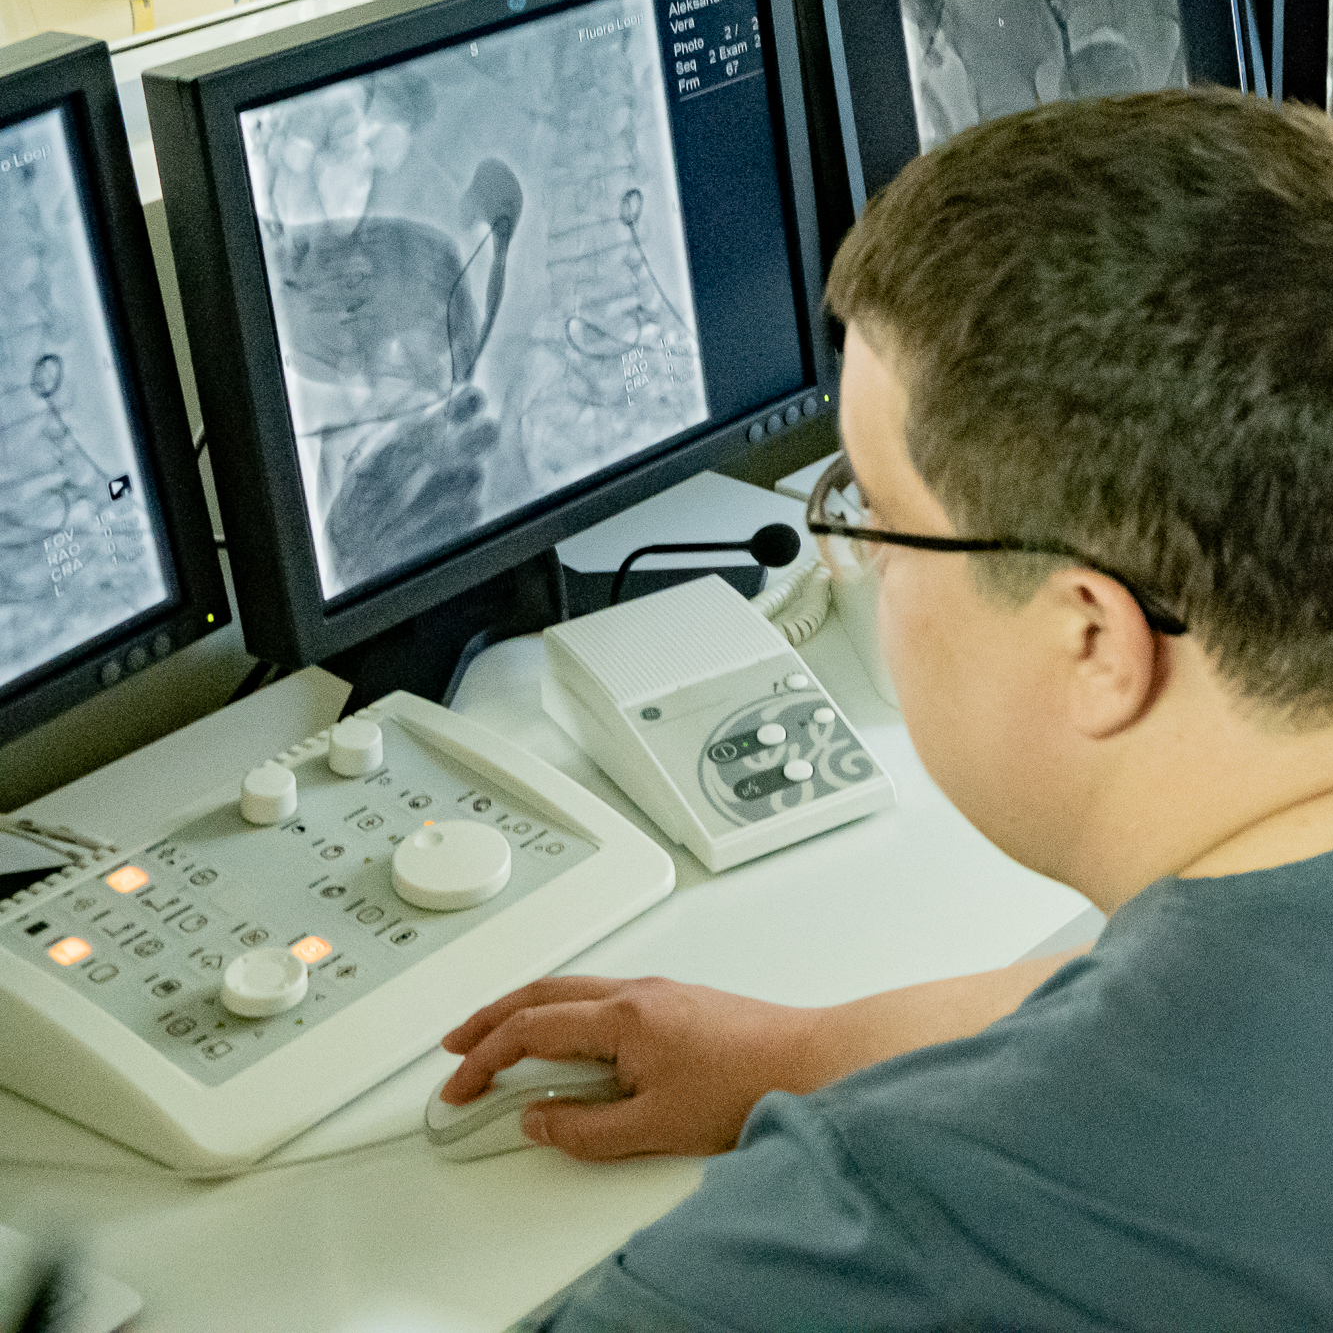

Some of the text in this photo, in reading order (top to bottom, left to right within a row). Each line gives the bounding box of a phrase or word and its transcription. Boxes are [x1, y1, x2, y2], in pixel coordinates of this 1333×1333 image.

[579, 22, 614, 43] Fluoro
[670, 17, 695, 35] Vera
[673, 38, 705, 58] Photo
[724, 26, 732, 40] 2
[752, 16, 759, 31] 2
[675, 34, 762, 76] Seq 2 Exam 2
[678, 59, 739, 94] Frm 67
[13, 144, 51, 167] Loop
[622, 347, 644, 366] FOV
[624, 360, 648, 379] RAO
[626, 373, 650, 393] CRA
[44, 527, 74, 553] FOV
[48, 542, 81, 567] RAO
[51, 558, 83, 582] CRA
